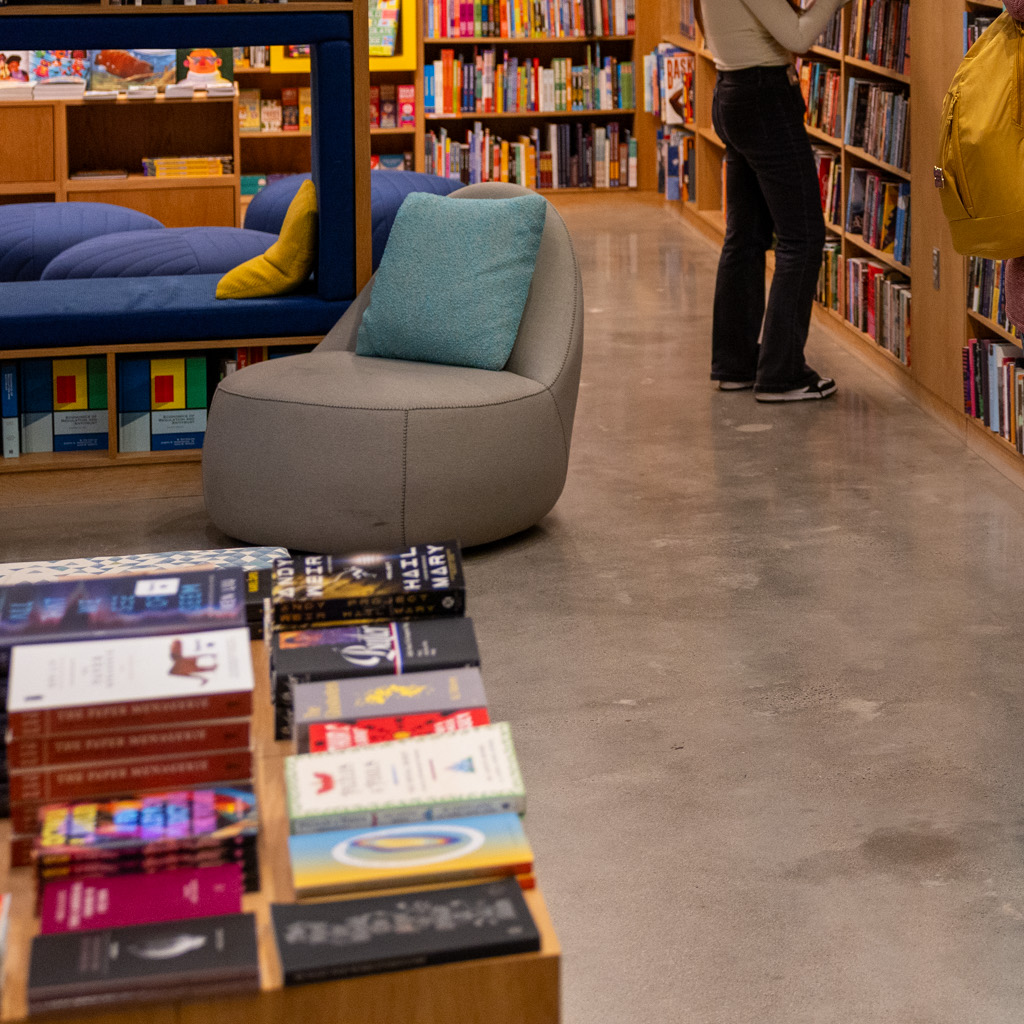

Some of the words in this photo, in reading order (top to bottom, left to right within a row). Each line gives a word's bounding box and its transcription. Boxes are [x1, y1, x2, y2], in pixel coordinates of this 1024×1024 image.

[276, 557, 295, 599] ANDY
[305, 555, 324, 598] WEIR
[402, 546, 422, 591] HAIL
[426, 543, 450, 590] MARY
